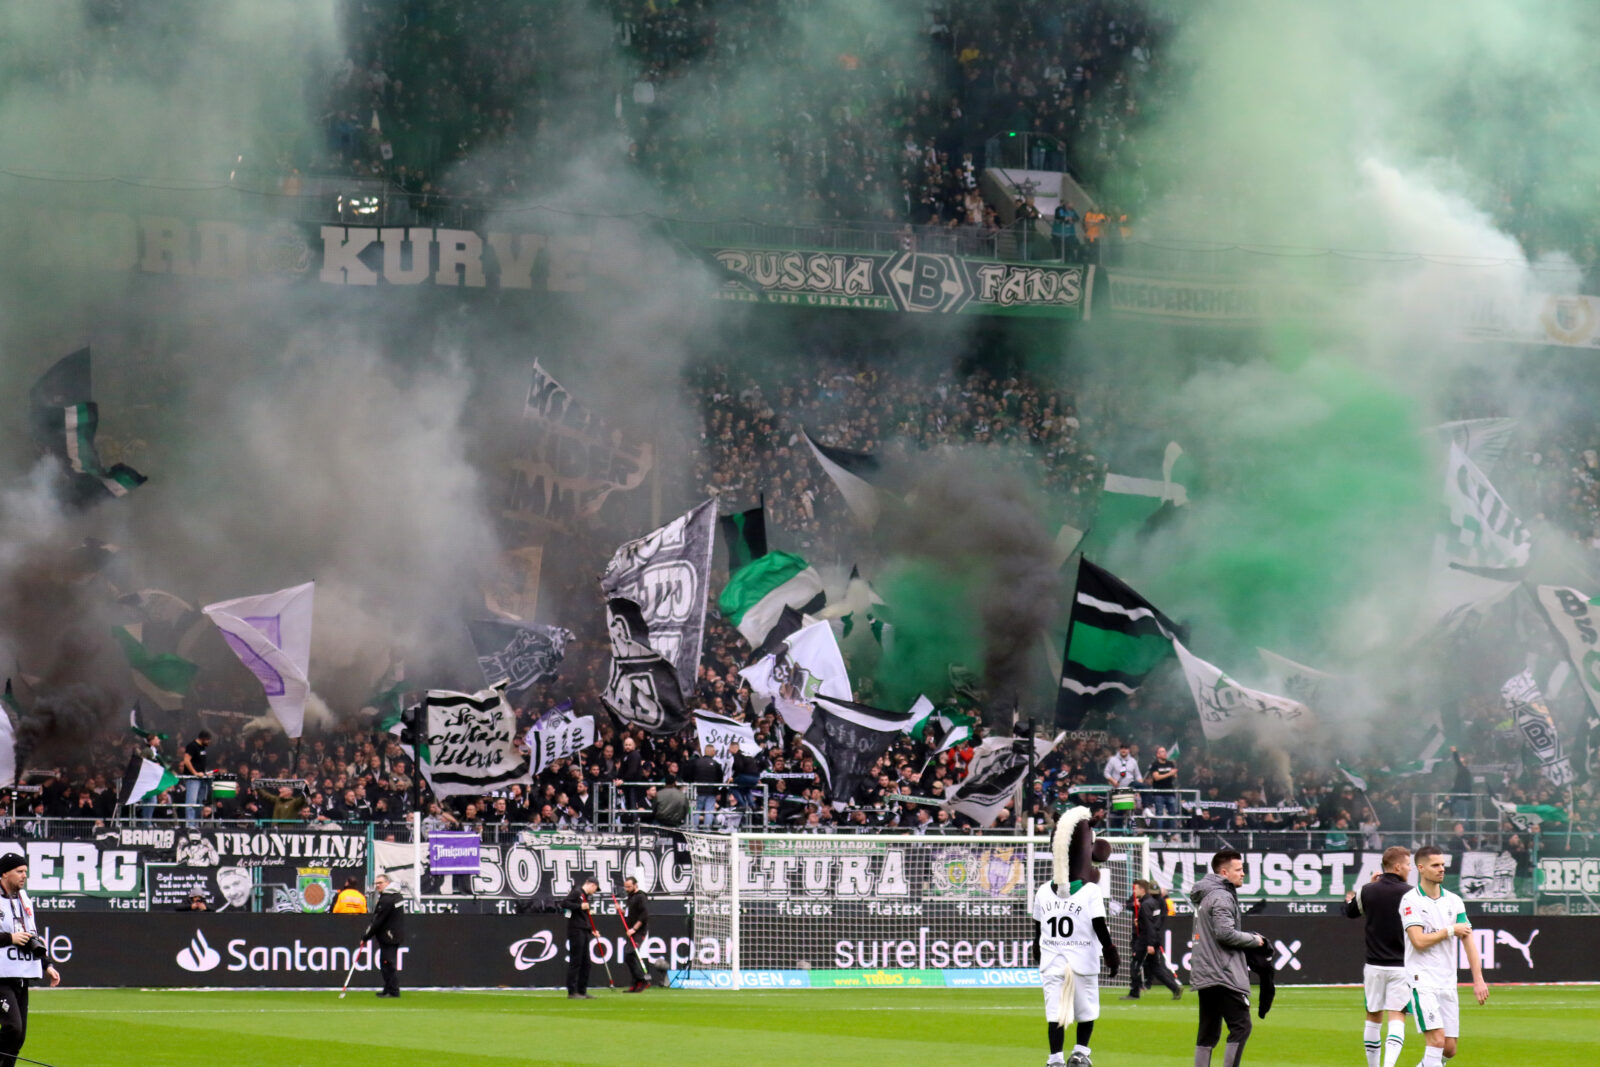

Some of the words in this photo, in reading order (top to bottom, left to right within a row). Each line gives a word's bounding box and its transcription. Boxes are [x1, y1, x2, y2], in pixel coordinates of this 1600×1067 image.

[320, 226, 590, 291] KURVE
[976, 266, 1083, 305] FANS
[122, 829, 175, 846] BANDA
[215, 832, 366, 858] FRONTLINE
[308, 858, 329, 868] seit
[332, 858, 363, 868] 2006
[470, 844, 911, 898] SOTTOCULTURA
[108, 898, 147, 909] flate
[776, 901, 832, 915] flatex
[867, 901, 923, 915] flatex
[956, 901, 1011, 915] flatex
[1288, 902, 1327, 913] flatex
[1481, 903, 1519, 913] flatex
[1046, 915, 1074, 938] 10
[707, 972, 785, 986] JONGEN
[980, 971, 1041, 985] JONGE
